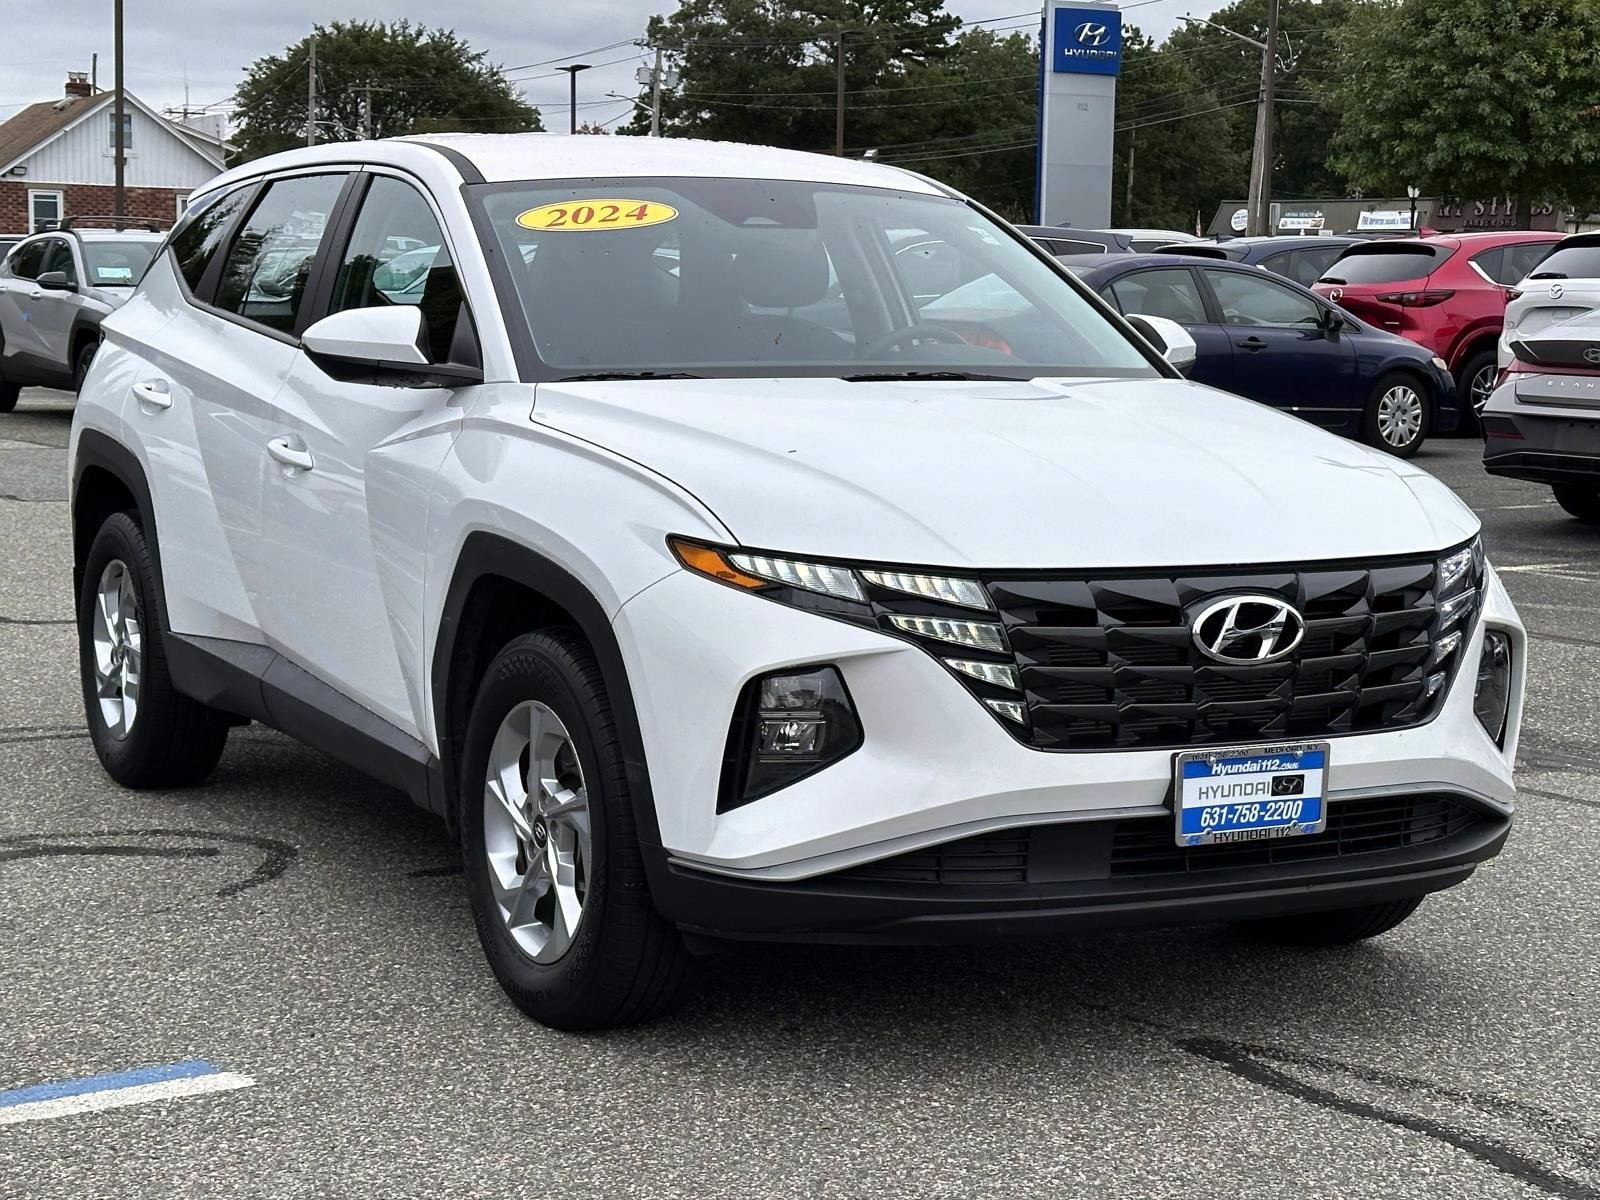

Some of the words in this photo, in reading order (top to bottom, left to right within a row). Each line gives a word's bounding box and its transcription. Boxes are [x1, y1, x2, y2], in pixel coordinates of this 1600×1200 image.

[1064, 48, 1117, 58] HYUNDAI
[545, 204, 648, 227] 2024
[1547, 380, 1594, 388] ELAN
[1211, 759, 1300, 776] Hyundai112.com
[1198, 781, 1271, 800] HYUNDAI
[1201, 801, 1303, 827] 631-758-2200
[1213, 829, 1270, 843] HYUNDAI
[1276, 827, 1290, 837] 112
